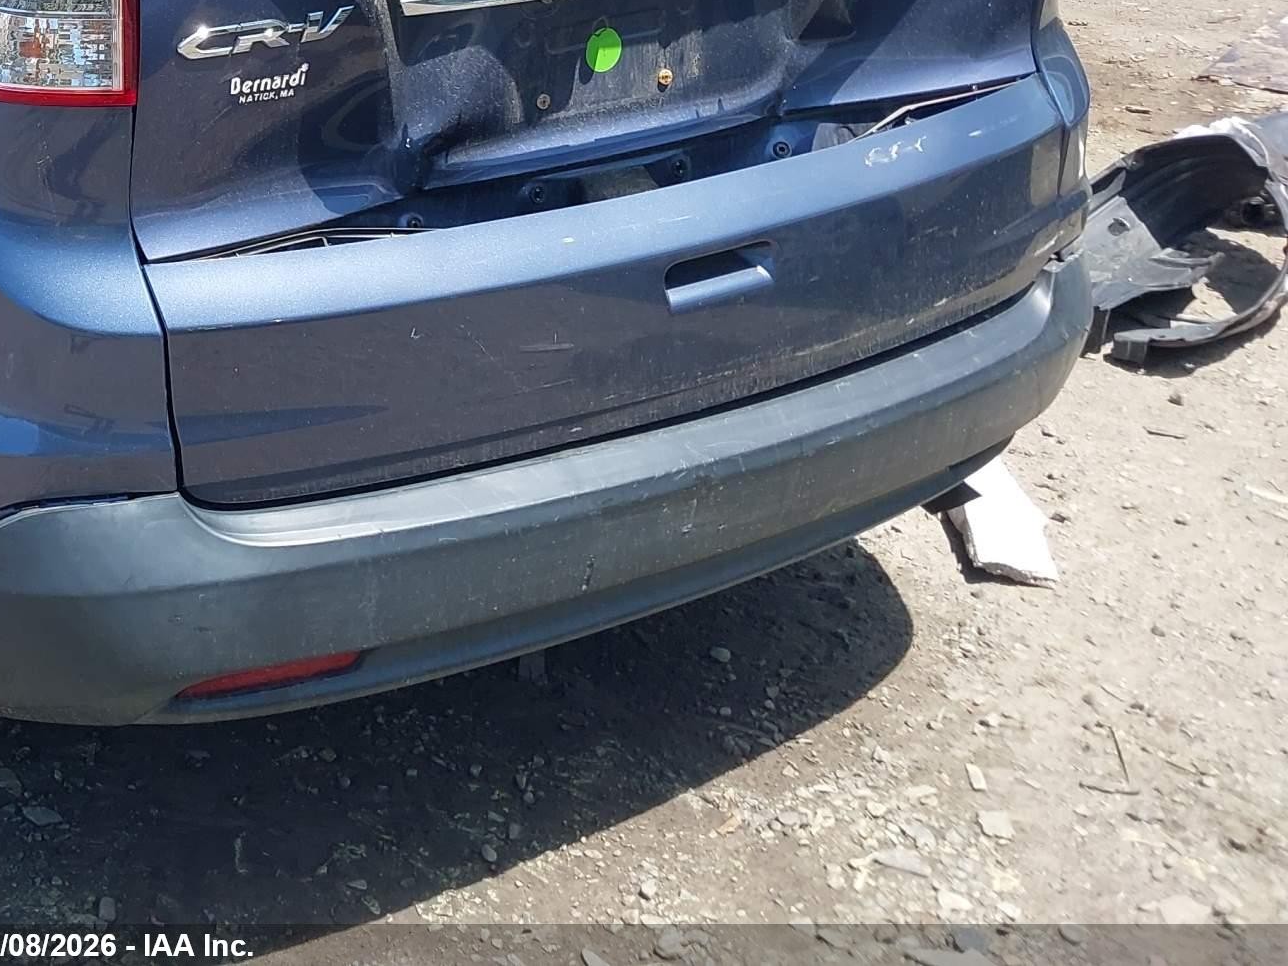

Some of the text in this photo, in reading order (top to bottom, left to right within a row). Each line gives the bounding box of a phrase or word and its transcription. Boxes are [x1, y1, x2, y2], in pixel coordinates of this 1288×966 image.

[177, 5, 355, 60] CR-V
[230, 63, 309, 95] Bernardi
[238, 89, 295, 104] NATICK, MA
